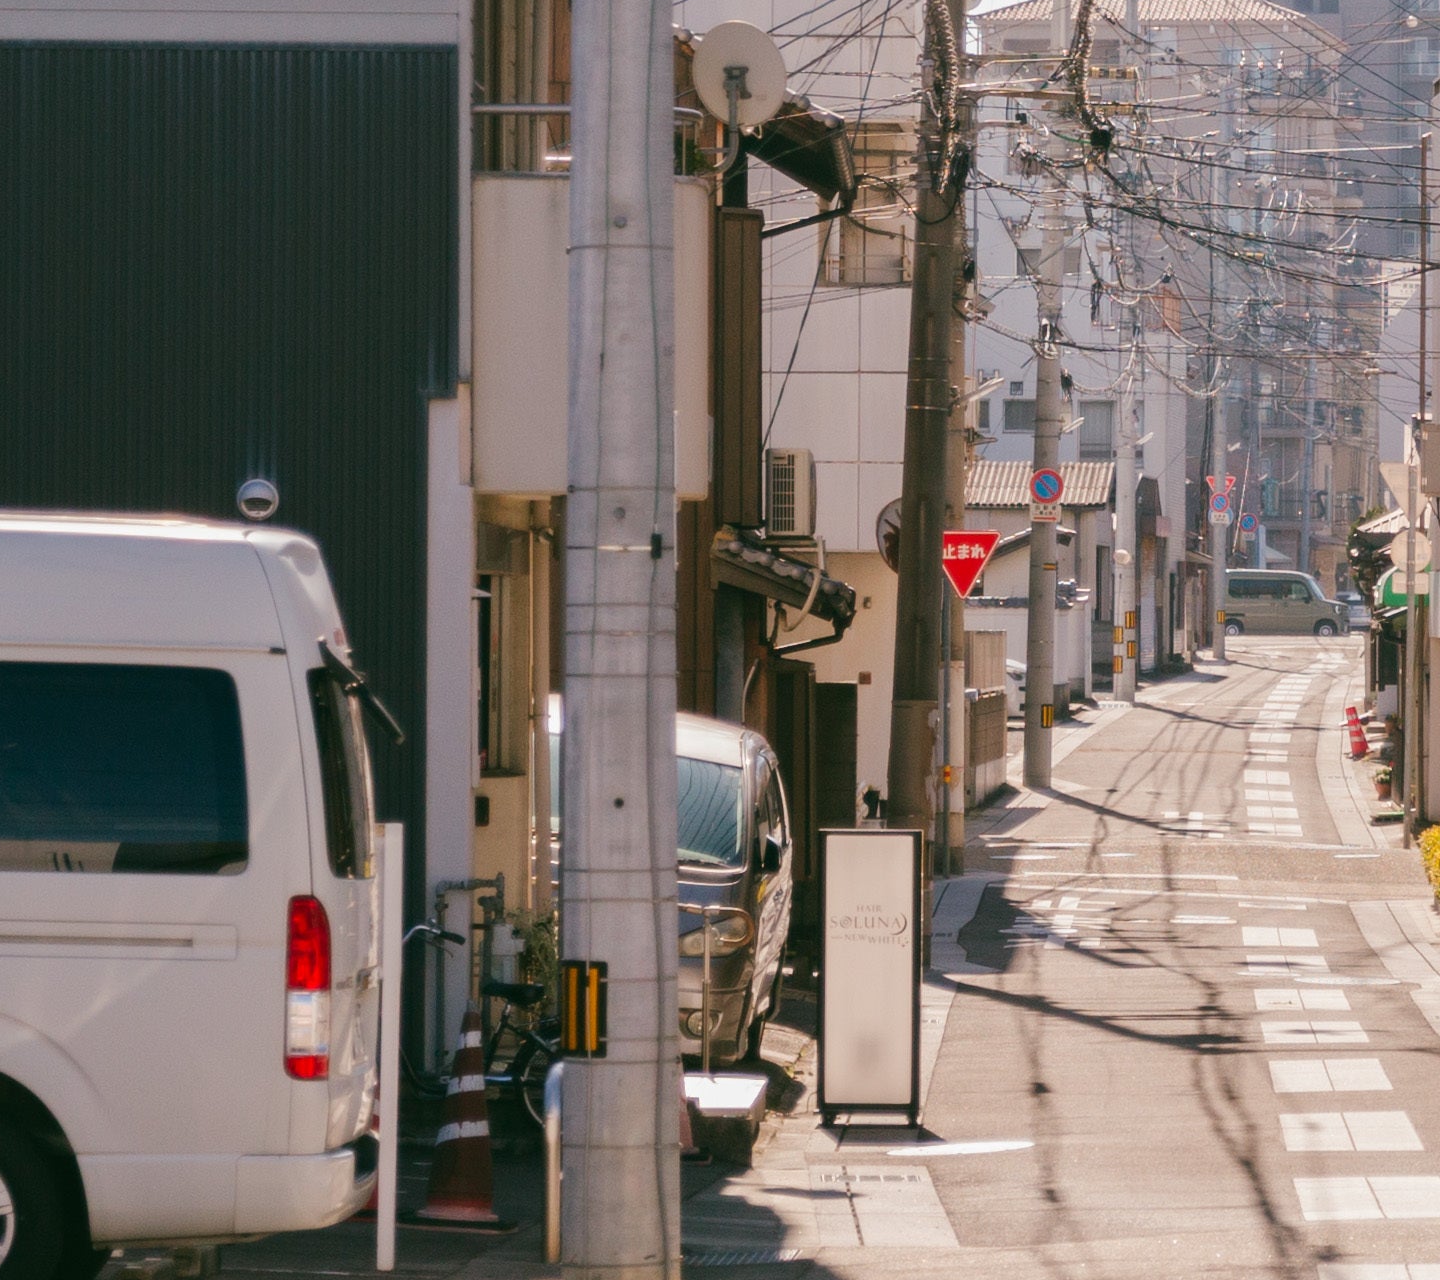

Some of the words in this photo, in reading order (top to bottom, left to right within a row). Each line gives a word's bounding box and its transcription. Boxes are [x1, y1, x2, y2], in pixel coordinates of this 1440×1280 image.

[943, 543, 986, 559] 止まれ
[856, 904, 882, 913] HAIR
[829, 915, 903, 929] SOLUNA
